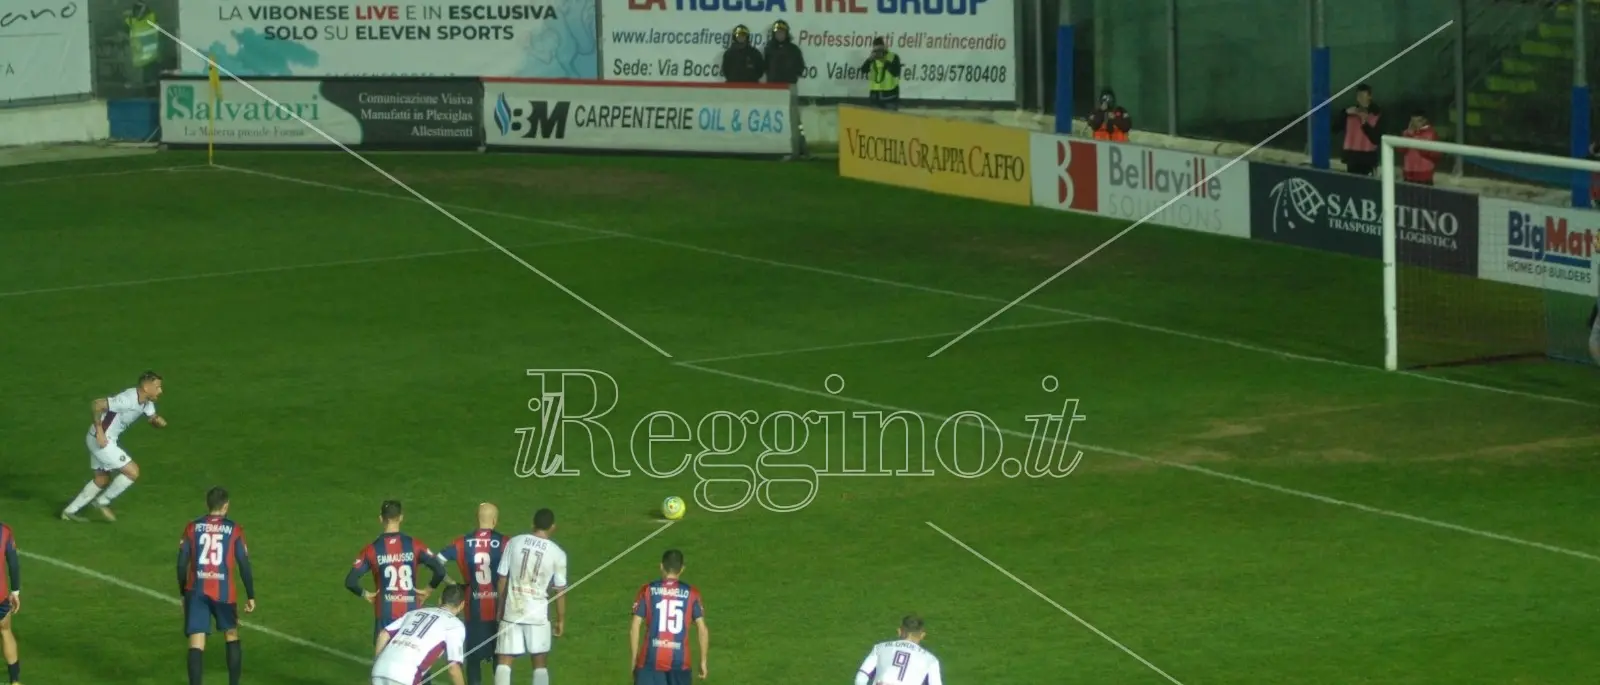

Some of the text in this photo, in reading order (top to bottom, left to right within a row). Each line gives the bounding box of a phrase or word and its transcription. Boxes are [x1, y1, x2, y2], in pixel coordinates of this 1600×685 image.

[219, 5, 558, 21] LA VIBONESE LIVE E IN ESCLUSIVA
[264, 25, 514, 41] SOLO SU ELEVEN SPORTS
[613, 58, 653, 77] Sede:
[657, 58, 679, 77] Via
[167, 84, 320, 121] Salvatori
[358, 92, 473, 105] Comunicazione Visiva
[361, 108, 472, 123] Manufatti in Plexiglas
[575, 104, 693, 130] CARPENTERIE
[699, 106, 725, 131] OIL
[731, 107, 742, 131] &
[747, 108, 784, 134] GAS
[411, 126, 473, 137] Allestimenti
[846, 128, 1025, 182] VECCHIA GRAPPA CAFFO
[1109, 146, 1221, 201] Bellaville
[1109, 193, 1222, 232] SOLUTIONS
[1327, 193, 1459, 236] SABTINO
[1400, 230, 1458, 250] LOGISTICA
[1508, 210, 1592, 261] BigMat
[1507, 260, 1533, 274] HOME
[1549, 267, 1591, 283] BUILDERS
[199, 533, 223, 566] 25
[466, 538, 500, 549] TITO
[384, 564, 413, 591] 28
[474, 552, 491, 585] 3
[520, 548, 543, 583] 11
[402, 611, 439, 639] 31
[656, 599, 684, 635] 15
[892, 650, 911, 682] 9
